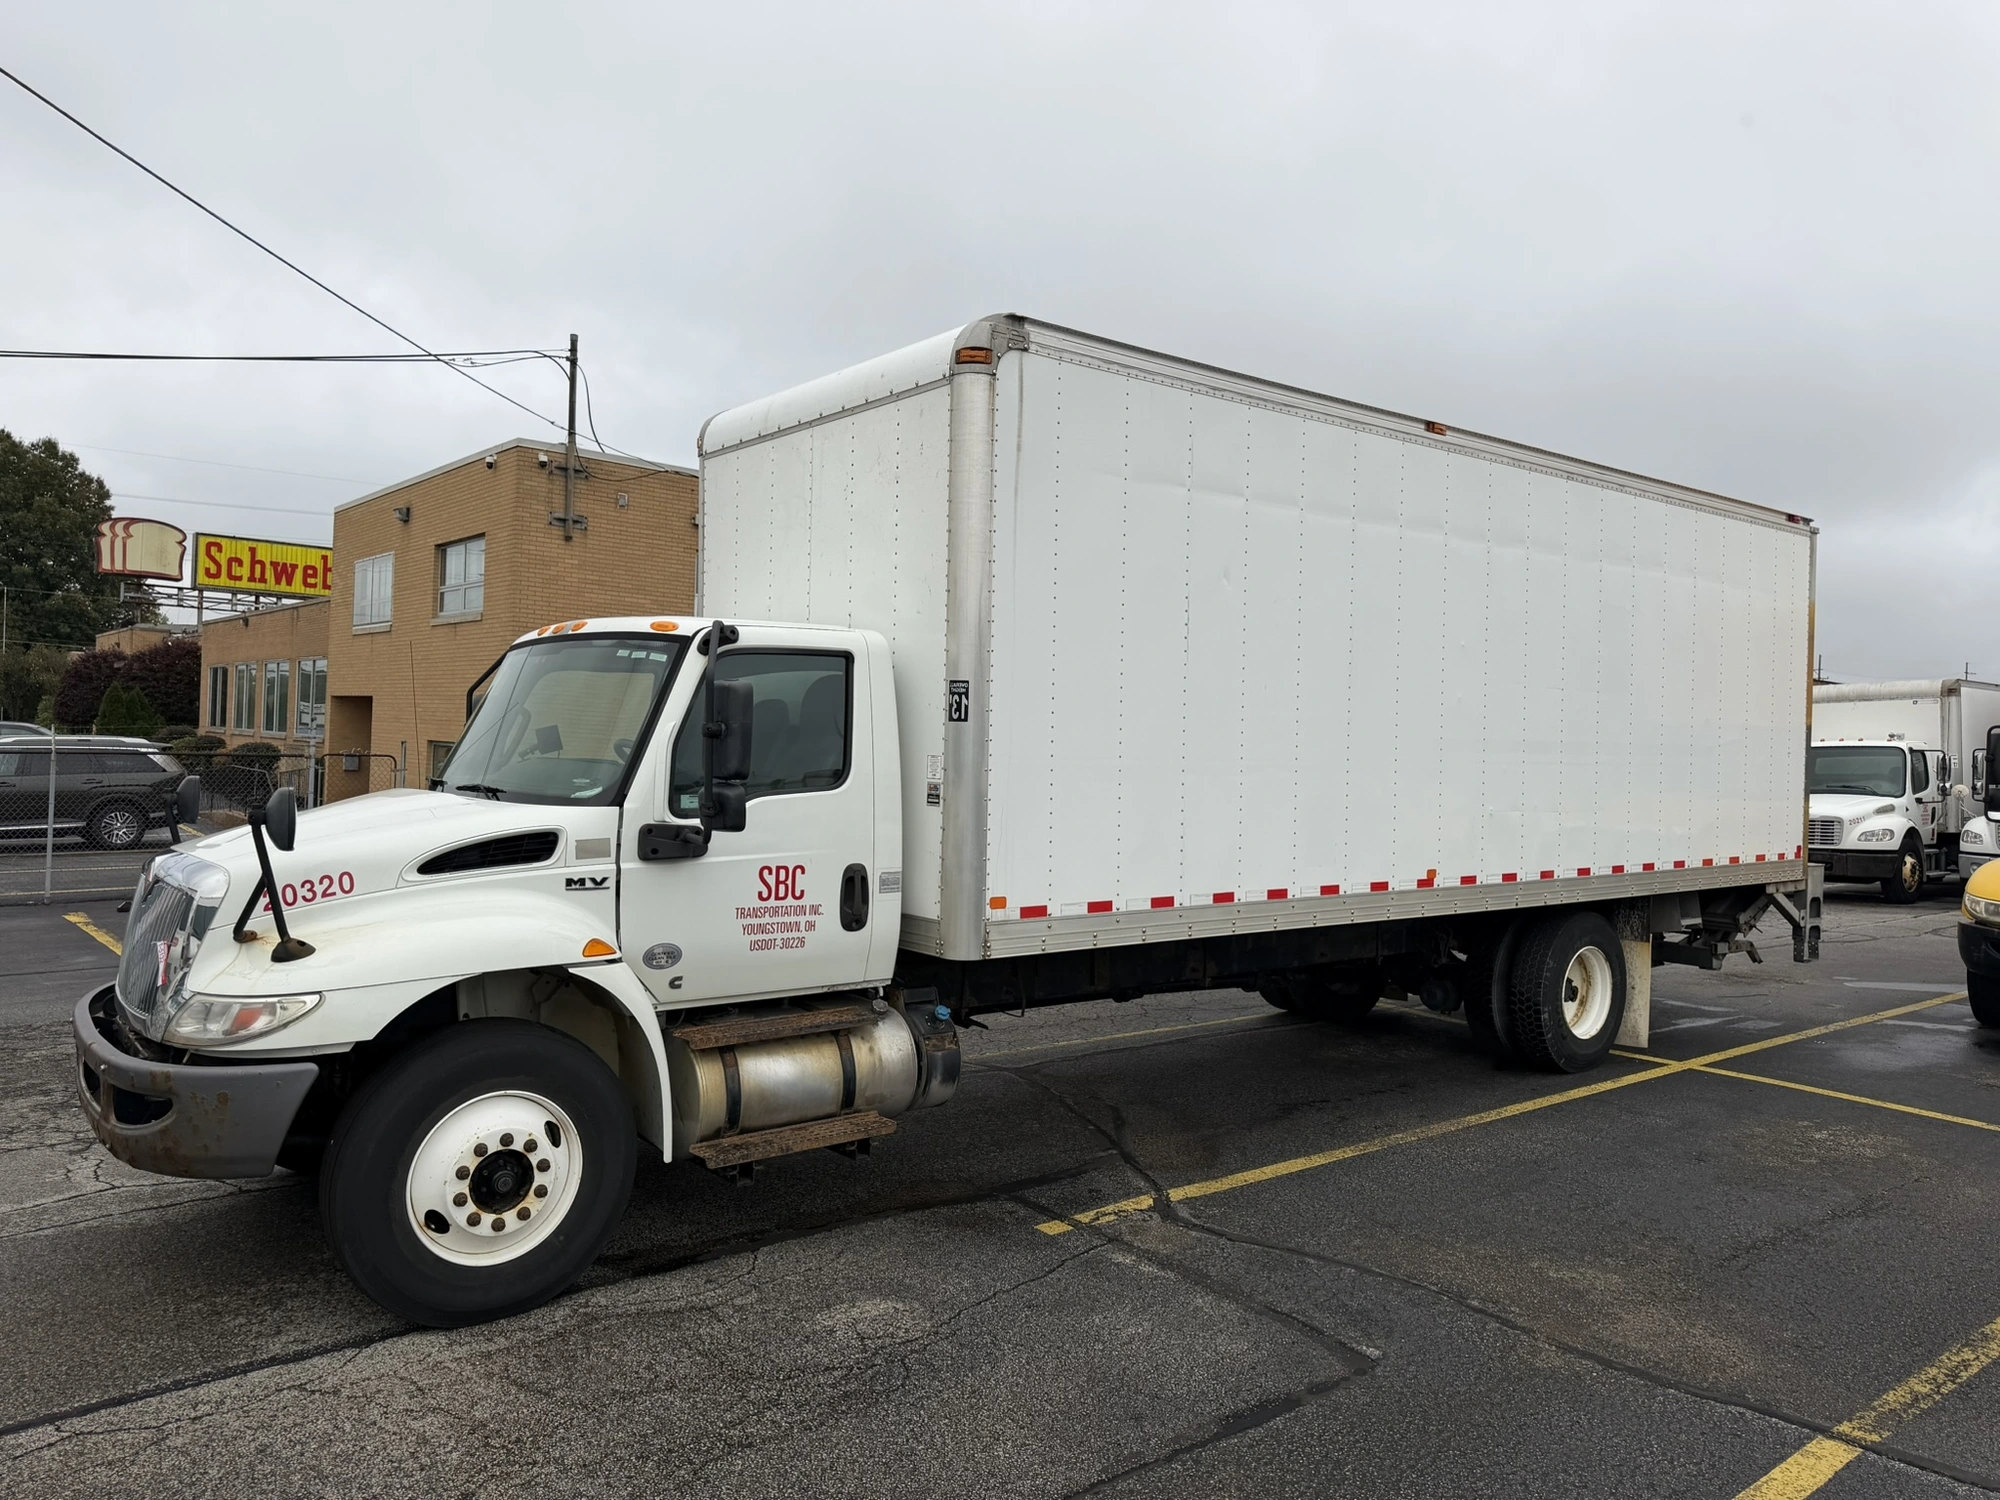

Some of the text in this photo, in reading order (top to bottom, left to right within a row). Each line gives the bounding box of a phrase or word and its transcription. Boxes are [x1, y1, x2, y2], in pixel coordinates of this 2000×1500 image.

[565, 876, 610, 888] MV
[757, 864, 806, 902] SBC
[735, 903, 824, 920] TRANSPORTATION INC.
[741, 920, 816, 936] YOUNGSTOWN, OH
[749, 936, 806, 951] USDOT-30226
